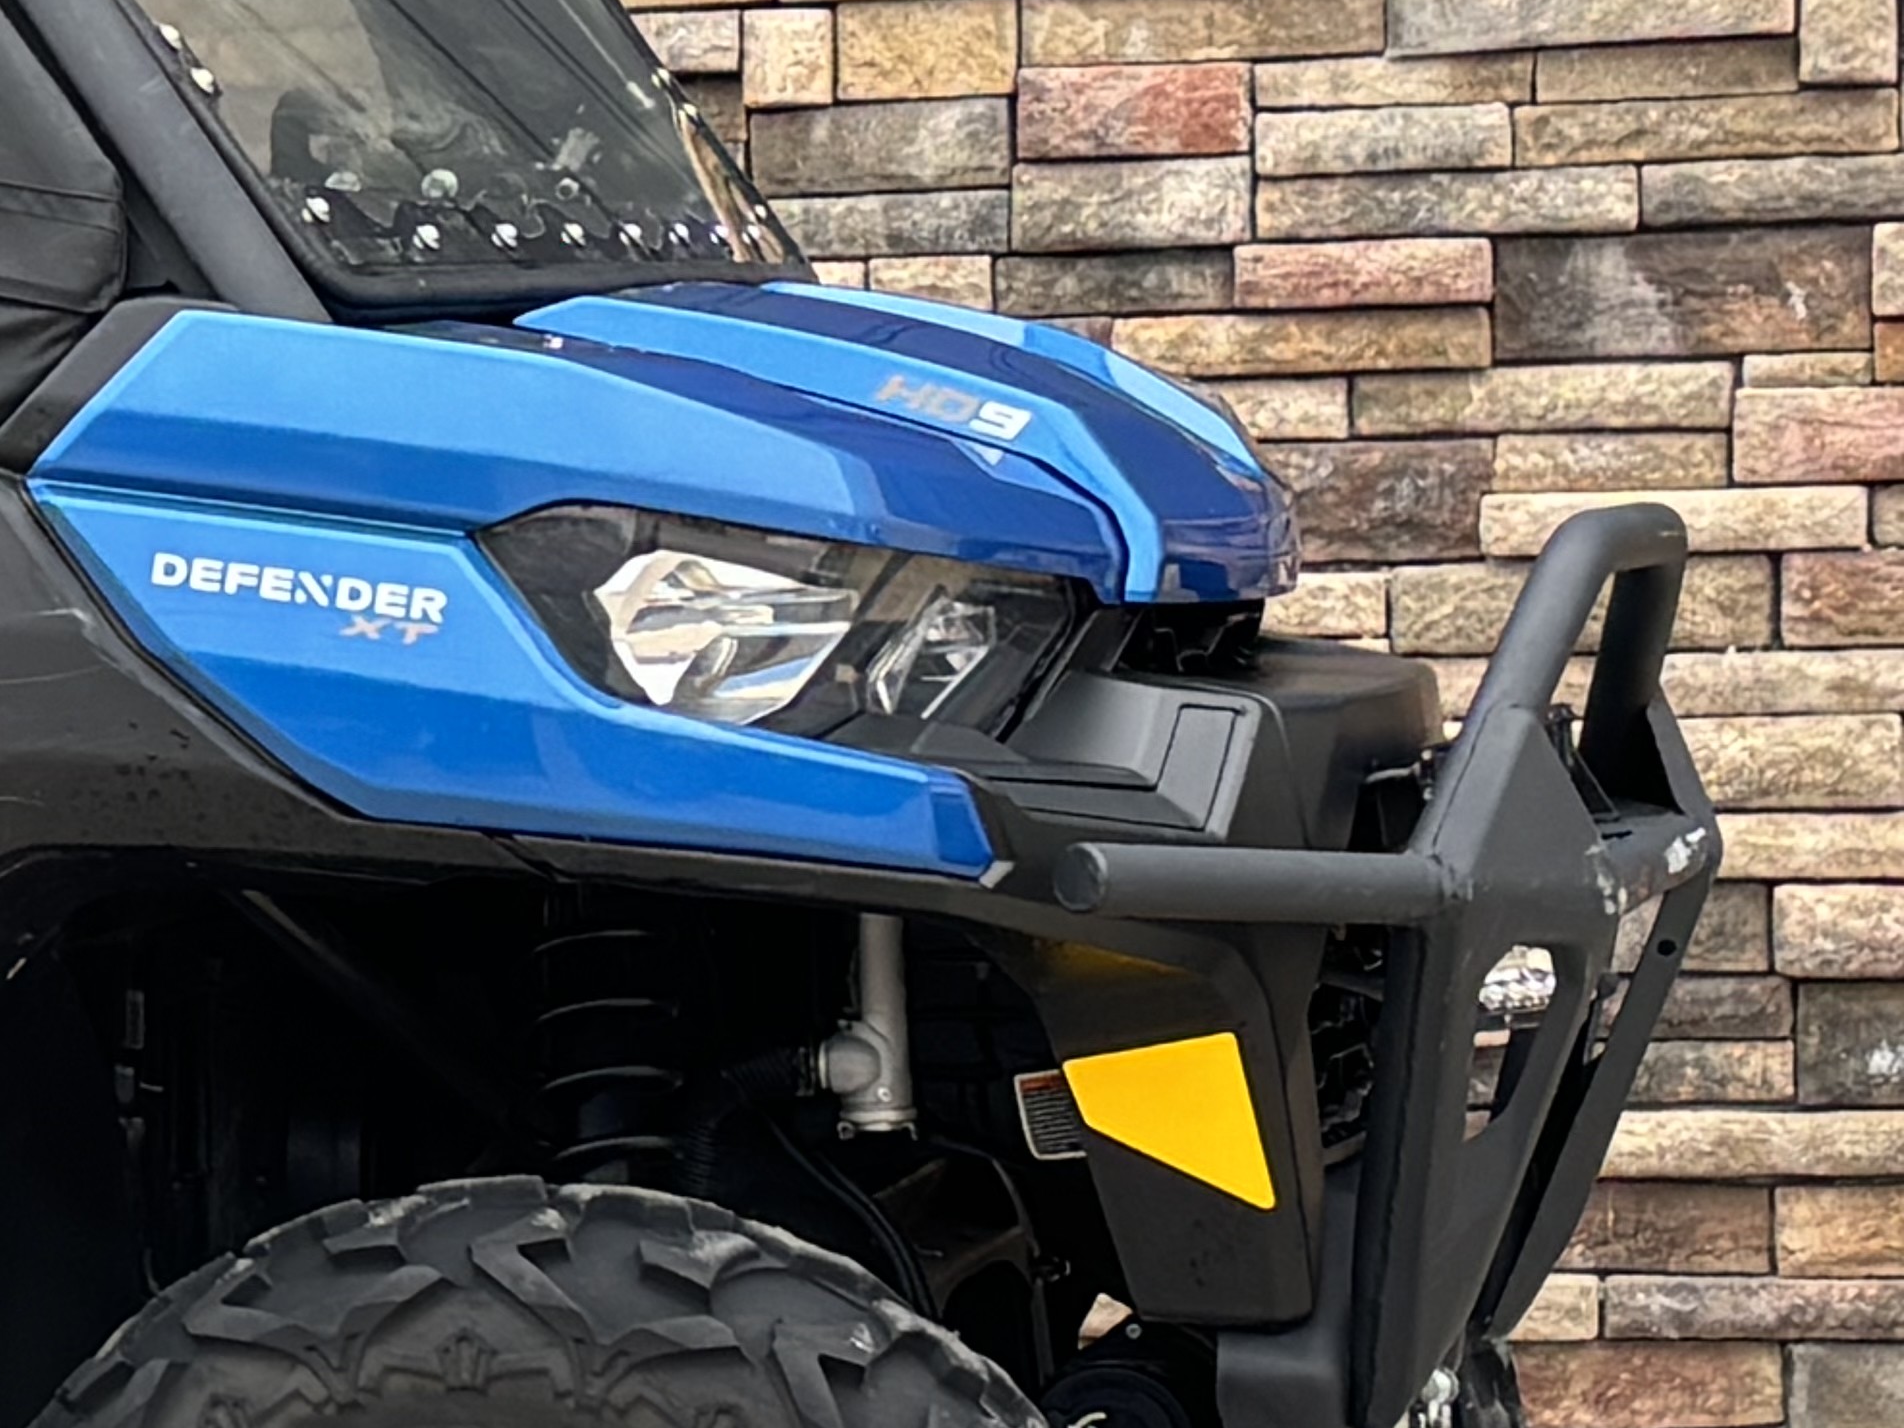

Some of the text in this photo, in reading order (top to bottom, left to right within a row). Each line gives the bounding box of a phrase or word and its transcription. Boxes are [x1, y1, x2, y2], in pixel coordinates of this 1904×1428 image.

[875, 375, 1033, 442] HD9
[151, 552, 448, 623] DEFENDER
[339, 614, 441, 645] XT
